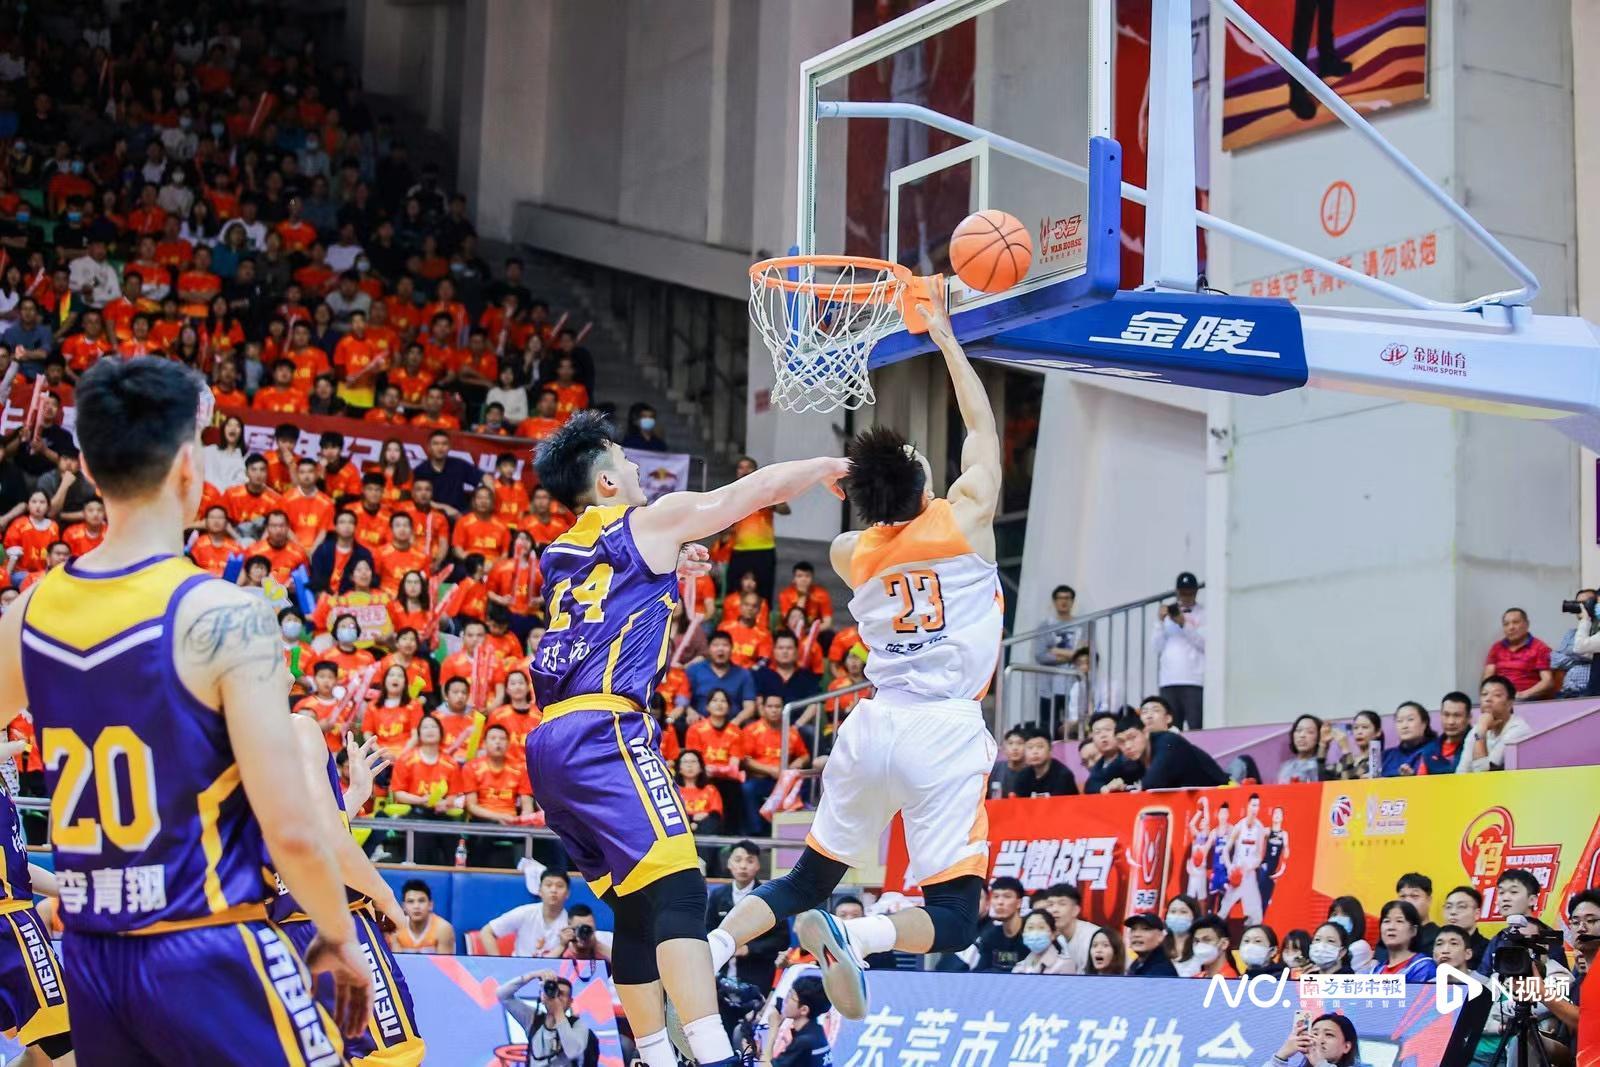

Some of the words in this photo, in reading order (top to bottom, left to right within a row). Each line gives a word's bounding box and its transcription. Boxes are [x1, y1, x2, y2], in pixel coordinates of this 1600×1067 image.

[1103, 311, 1268, 355] 金陵
[1412, 363, 1438, 373] JINLING
[1440, 368, 1467, 377] SPORTS
[1414, 346, 1466, 369] 金陵体育
[881, 569, 946, 633] 23
[42, 726, 162, 854] 20
